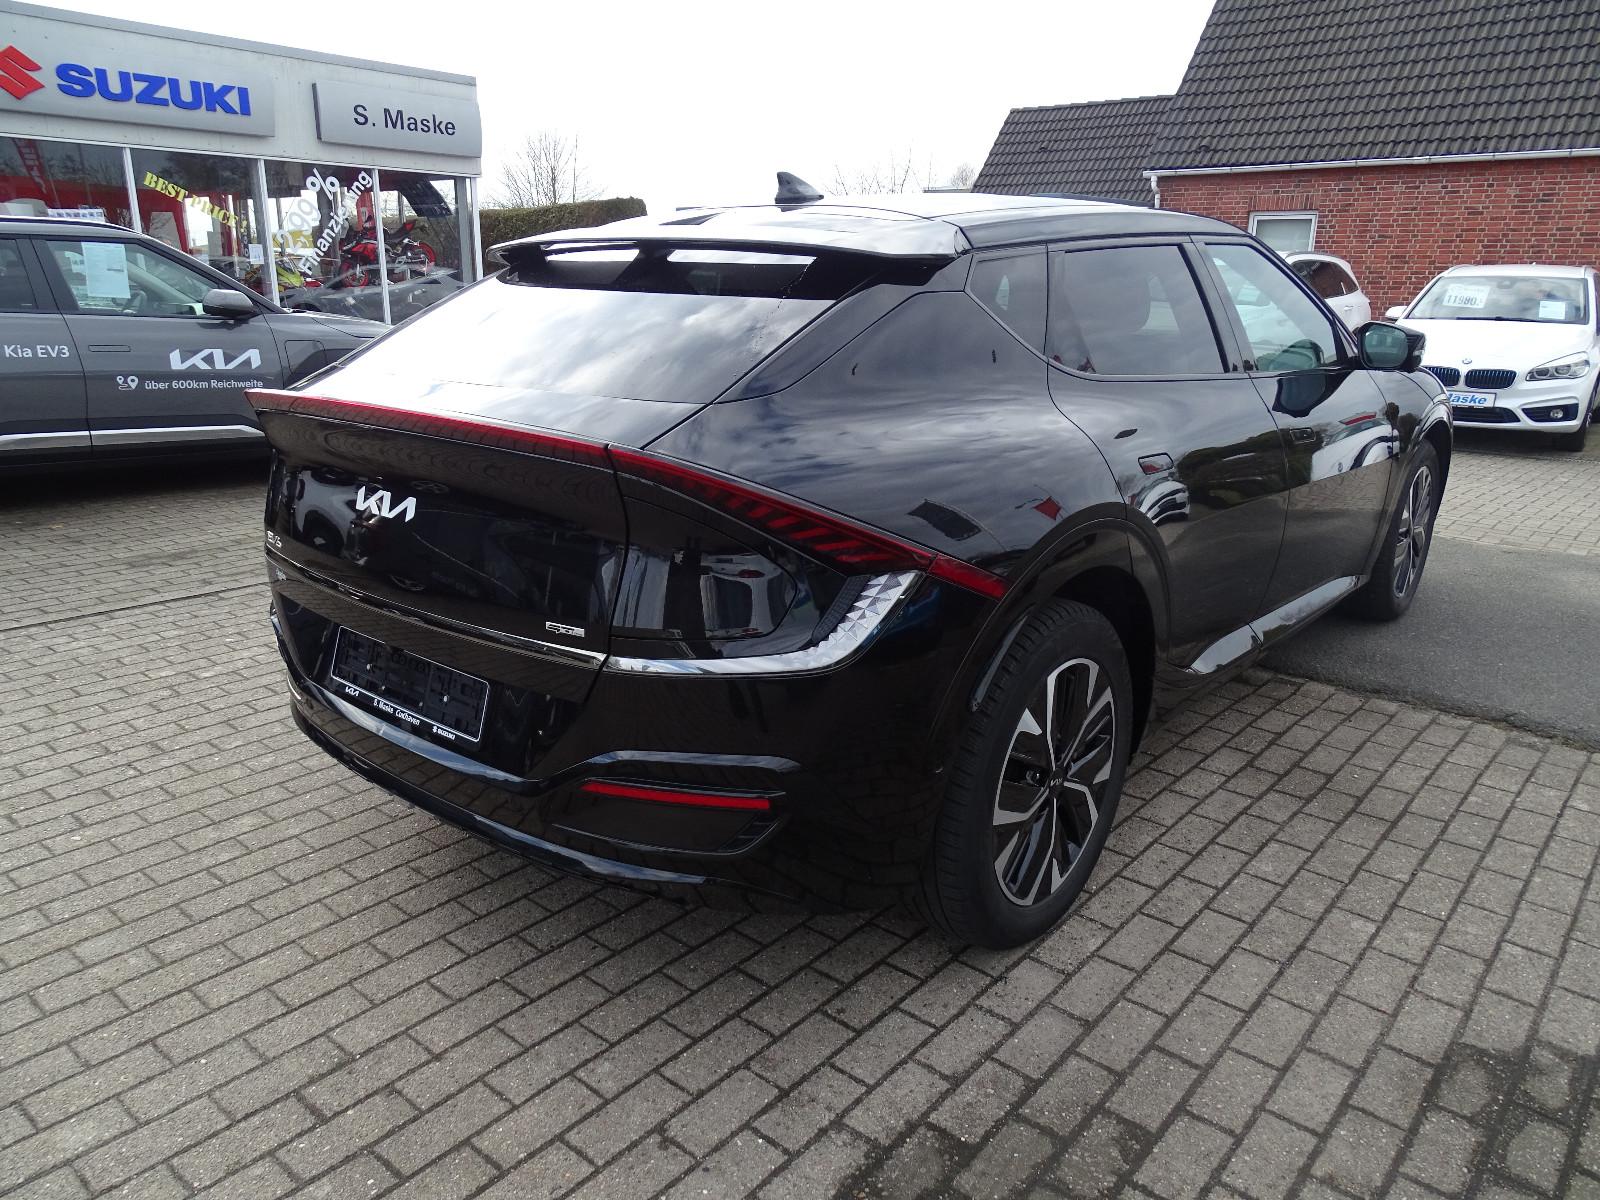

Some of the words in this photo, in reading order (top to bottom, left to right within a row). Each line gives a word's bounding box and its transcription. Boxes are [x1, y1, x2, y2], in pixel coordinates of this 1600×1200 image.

[55, 63, 251, 116] SUZUKI
[353, 104, 376, 127] S.
[383, 107, 457, 136] Maske
[143, 171, 189, 203] BEST
[190, 194, 239, 229] PRICE
[306, 167, 340, 201] %
[298, 170, 373, 276] Finanzierung
[3, 344, 33, 358] Kia
[36, 344, 70, 358] EV3
[169, 348, 262, 370] KIA
[144, 380, 170, 390] über
[172, 379, 209, 389] 600km
[211, 378, 264, 389] Reichweite
[355, 485, 417, 523] KIA
